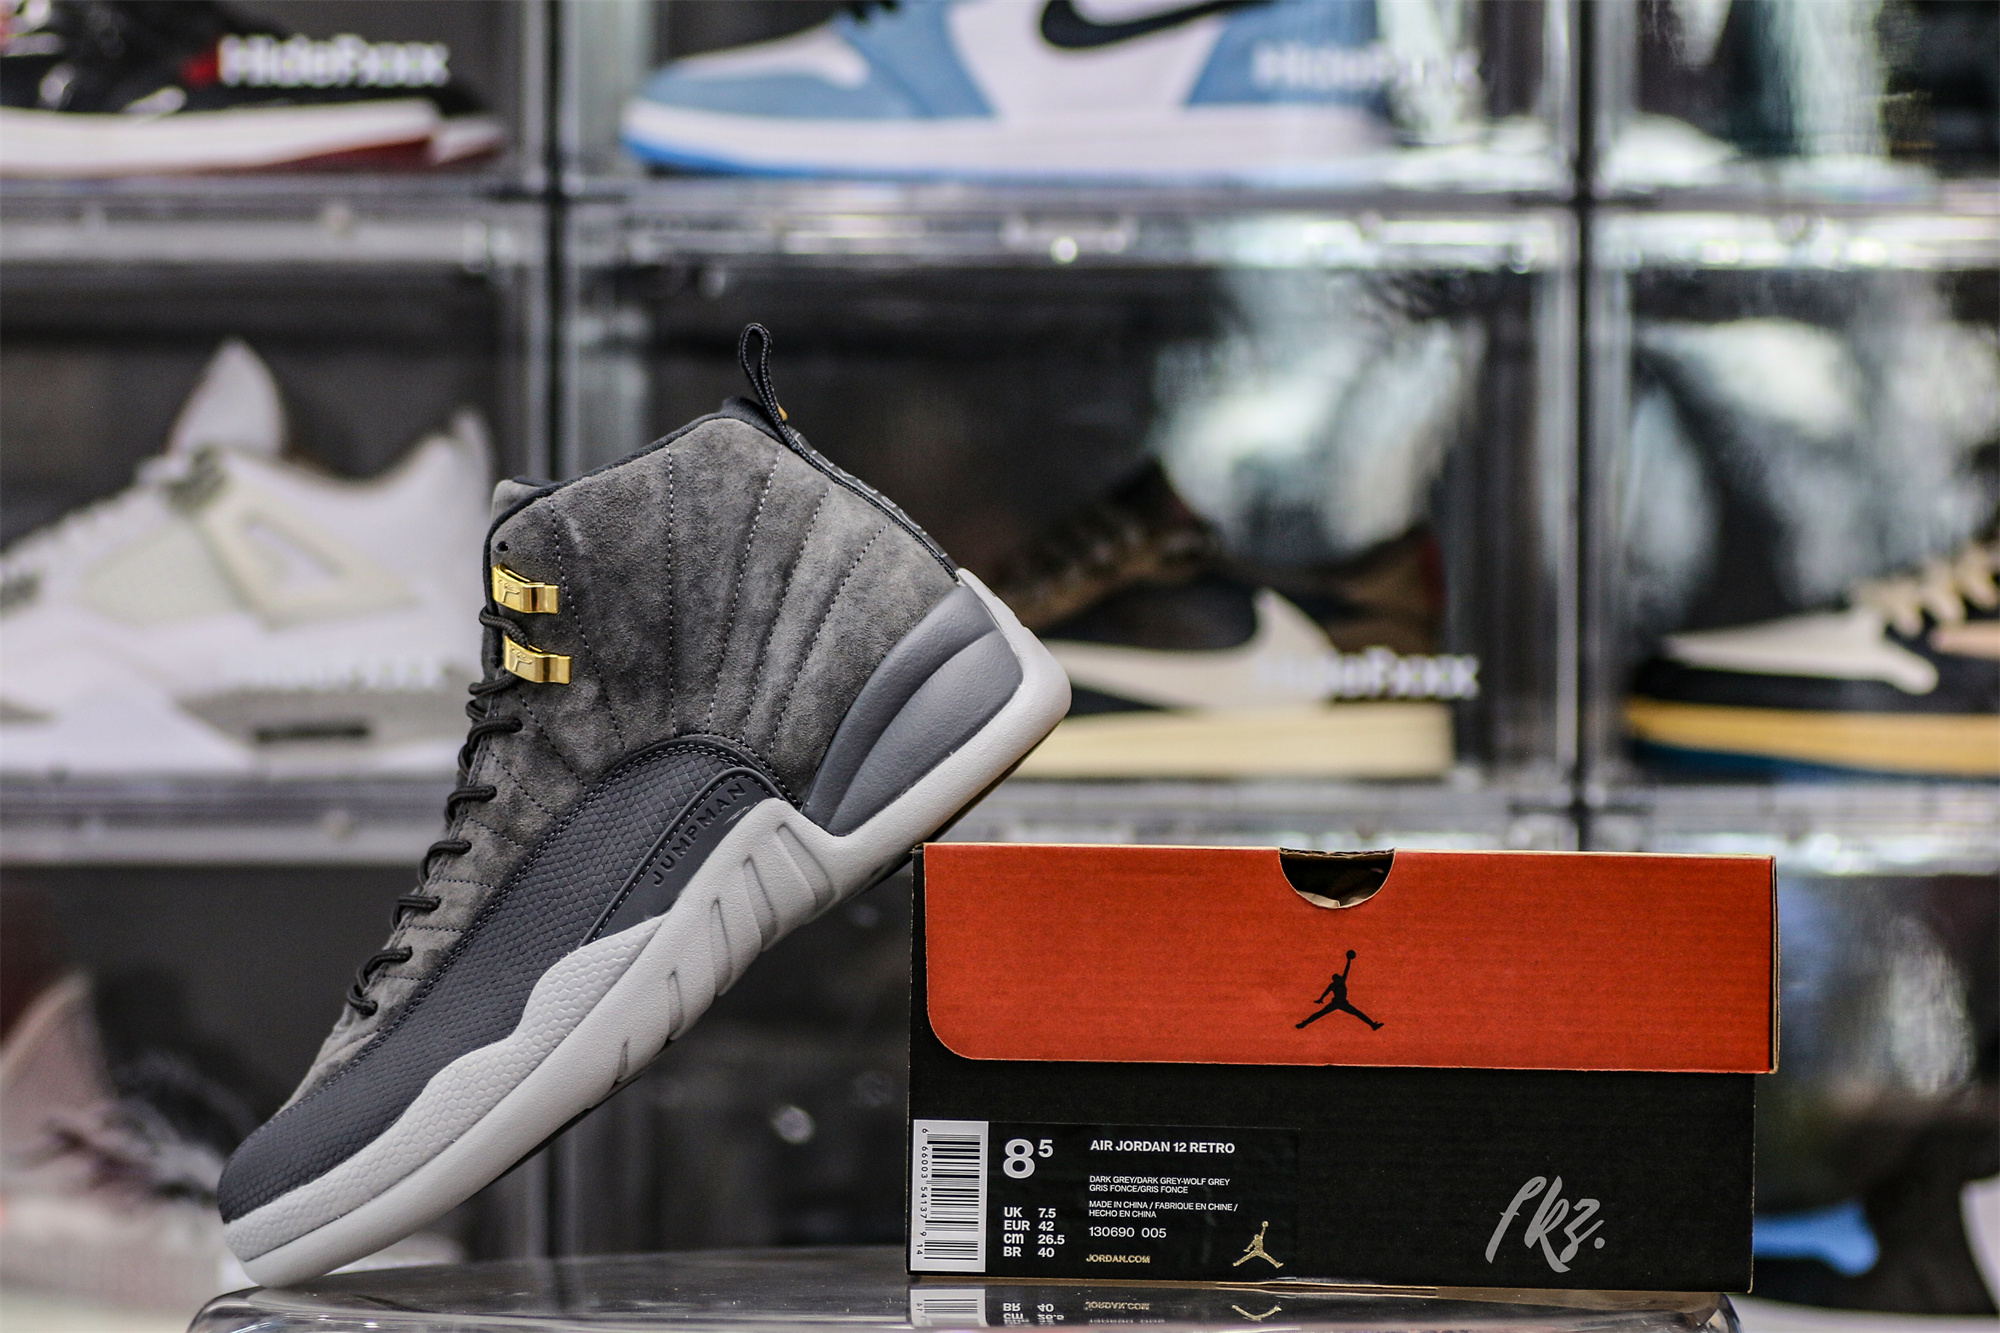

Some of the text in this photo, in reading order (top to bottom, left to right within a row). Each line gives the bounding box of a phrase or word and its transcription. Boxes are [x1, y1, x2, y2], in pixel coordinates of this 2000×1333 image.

[653, 782, 746, 887] JUMPMAN
[1090, 1139, 1236, 1154] AIR JORDAN 12 RETRO
[921, 1146, 929, 1179] 66003
[1089, 1175, 1231, 1186] DARK GREY/DARK GREY-WOLF GREY
[1089, 1184, 1189, 1194] GRIS FONCE/GRIS FONCE
[920, 1186, 928, 1219] 54137
[1088, 1200, 1112, 1208] MADE
[1113, 1201, 1122, 1209] IN
[1123, 1201, 1149, 1209] CHINA
[1154, 1202, 1194, 1211] FABRIQUE
[1195, 1203, 1206, 1211] EN
[1207, 1203, 1233, 1211] CHINE
[1004, 1206, 1057, 1218] UK 7.5
[1088, 1209, 1157, 1219] HECHO EN CHINA
[1003, 1220, 1055, 1231] EUR 42
[1088, 1226, 1167, 1239] 130690 005
[1037, 1234, 1065, 1245] 26.5
[916, 1243, 924, 1255] 14
[1003, 1246, 1055, 1258] BR 40
[1086, 1254, 1151, 1264] JORDAN.COM
